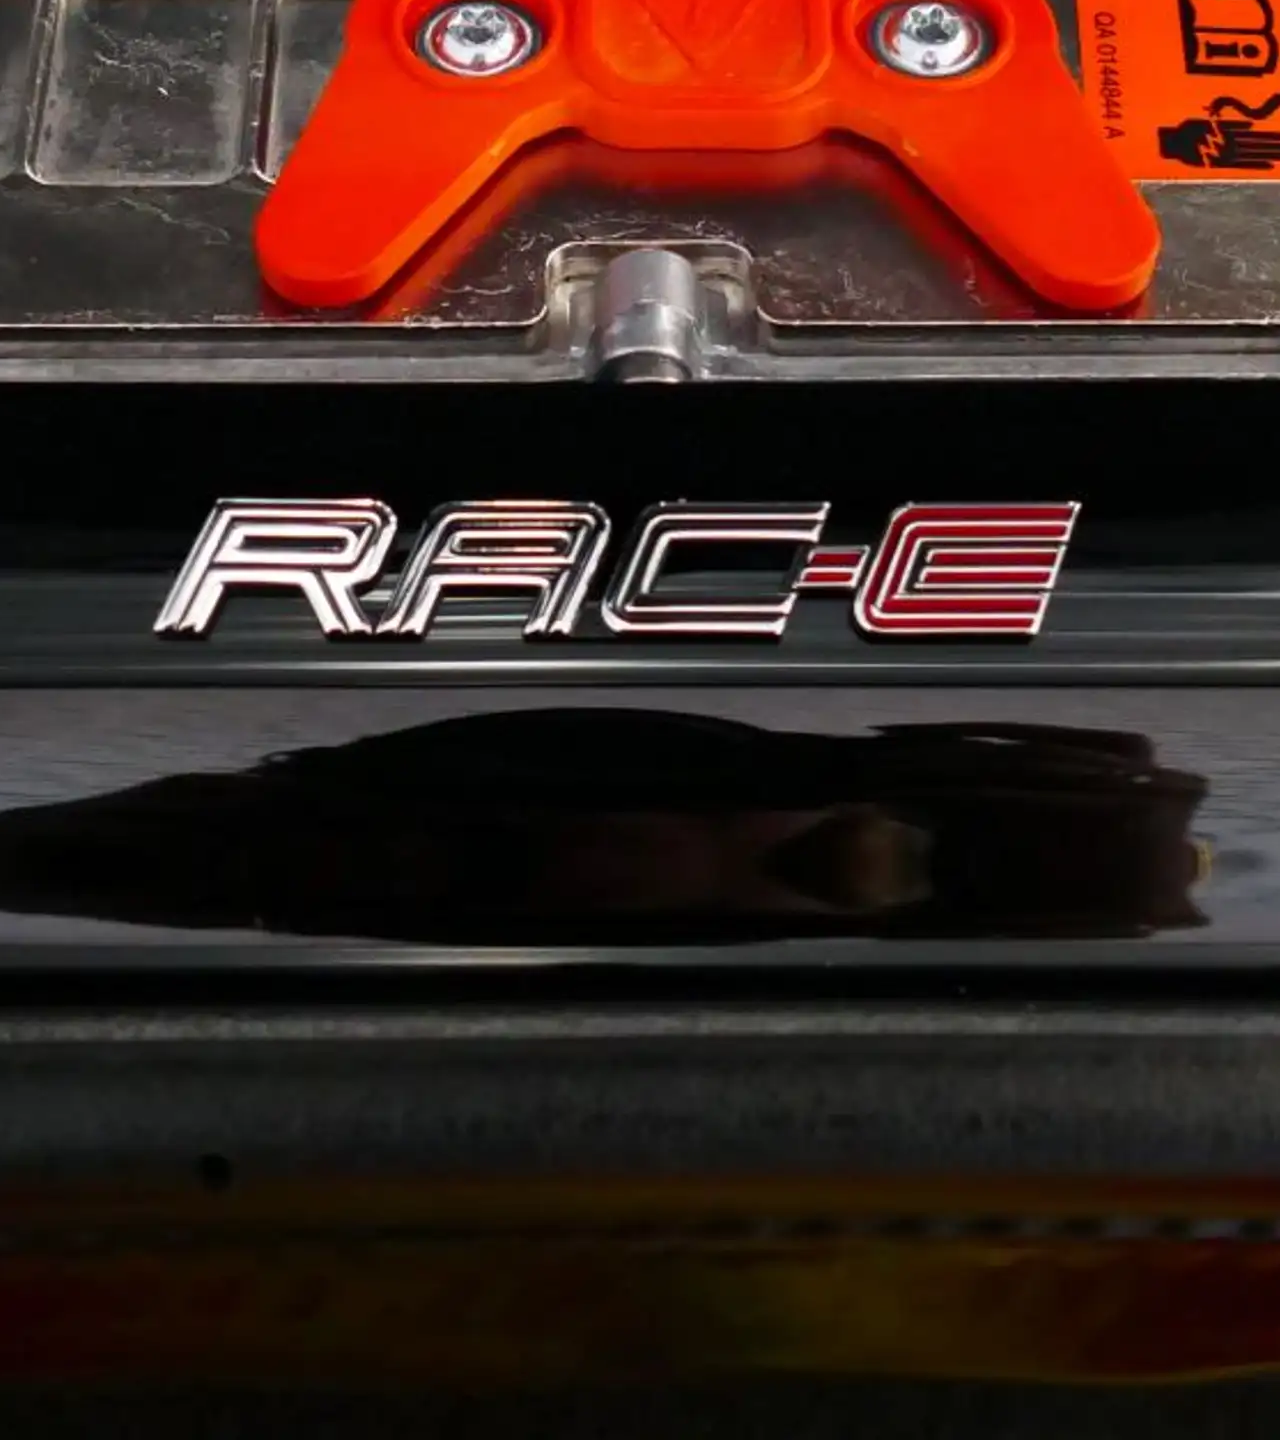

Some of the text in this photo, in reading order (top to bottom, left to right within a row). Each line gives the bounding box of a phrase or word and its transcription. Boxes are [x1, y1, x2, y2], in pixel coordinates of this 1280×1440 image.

[1093, 11, 1117, 39] QA
[1102, 126, 1126, 140] A
[153, 497, 1082, 639] RAC-E
